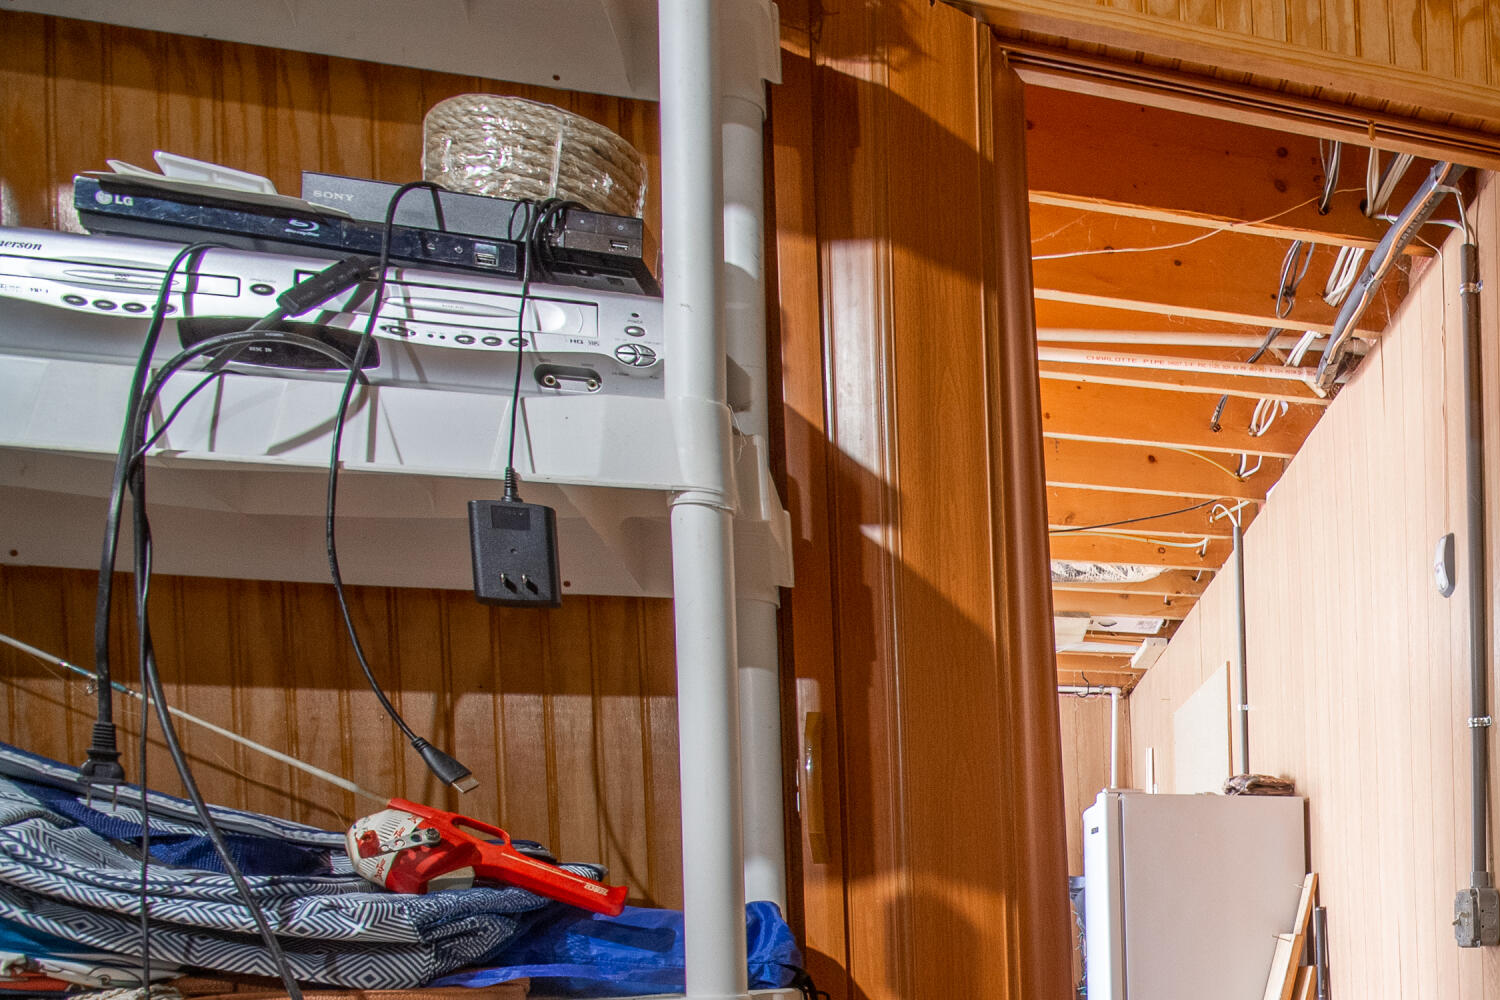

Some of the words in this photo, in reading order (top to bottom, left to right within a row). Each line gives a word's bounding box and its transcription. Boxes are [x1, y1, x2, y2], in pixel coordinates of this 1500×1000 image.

[114, 193, 134, 206] LG
[312, 190, 354, 201] SONY
[0, 239, 42, 250] erson
